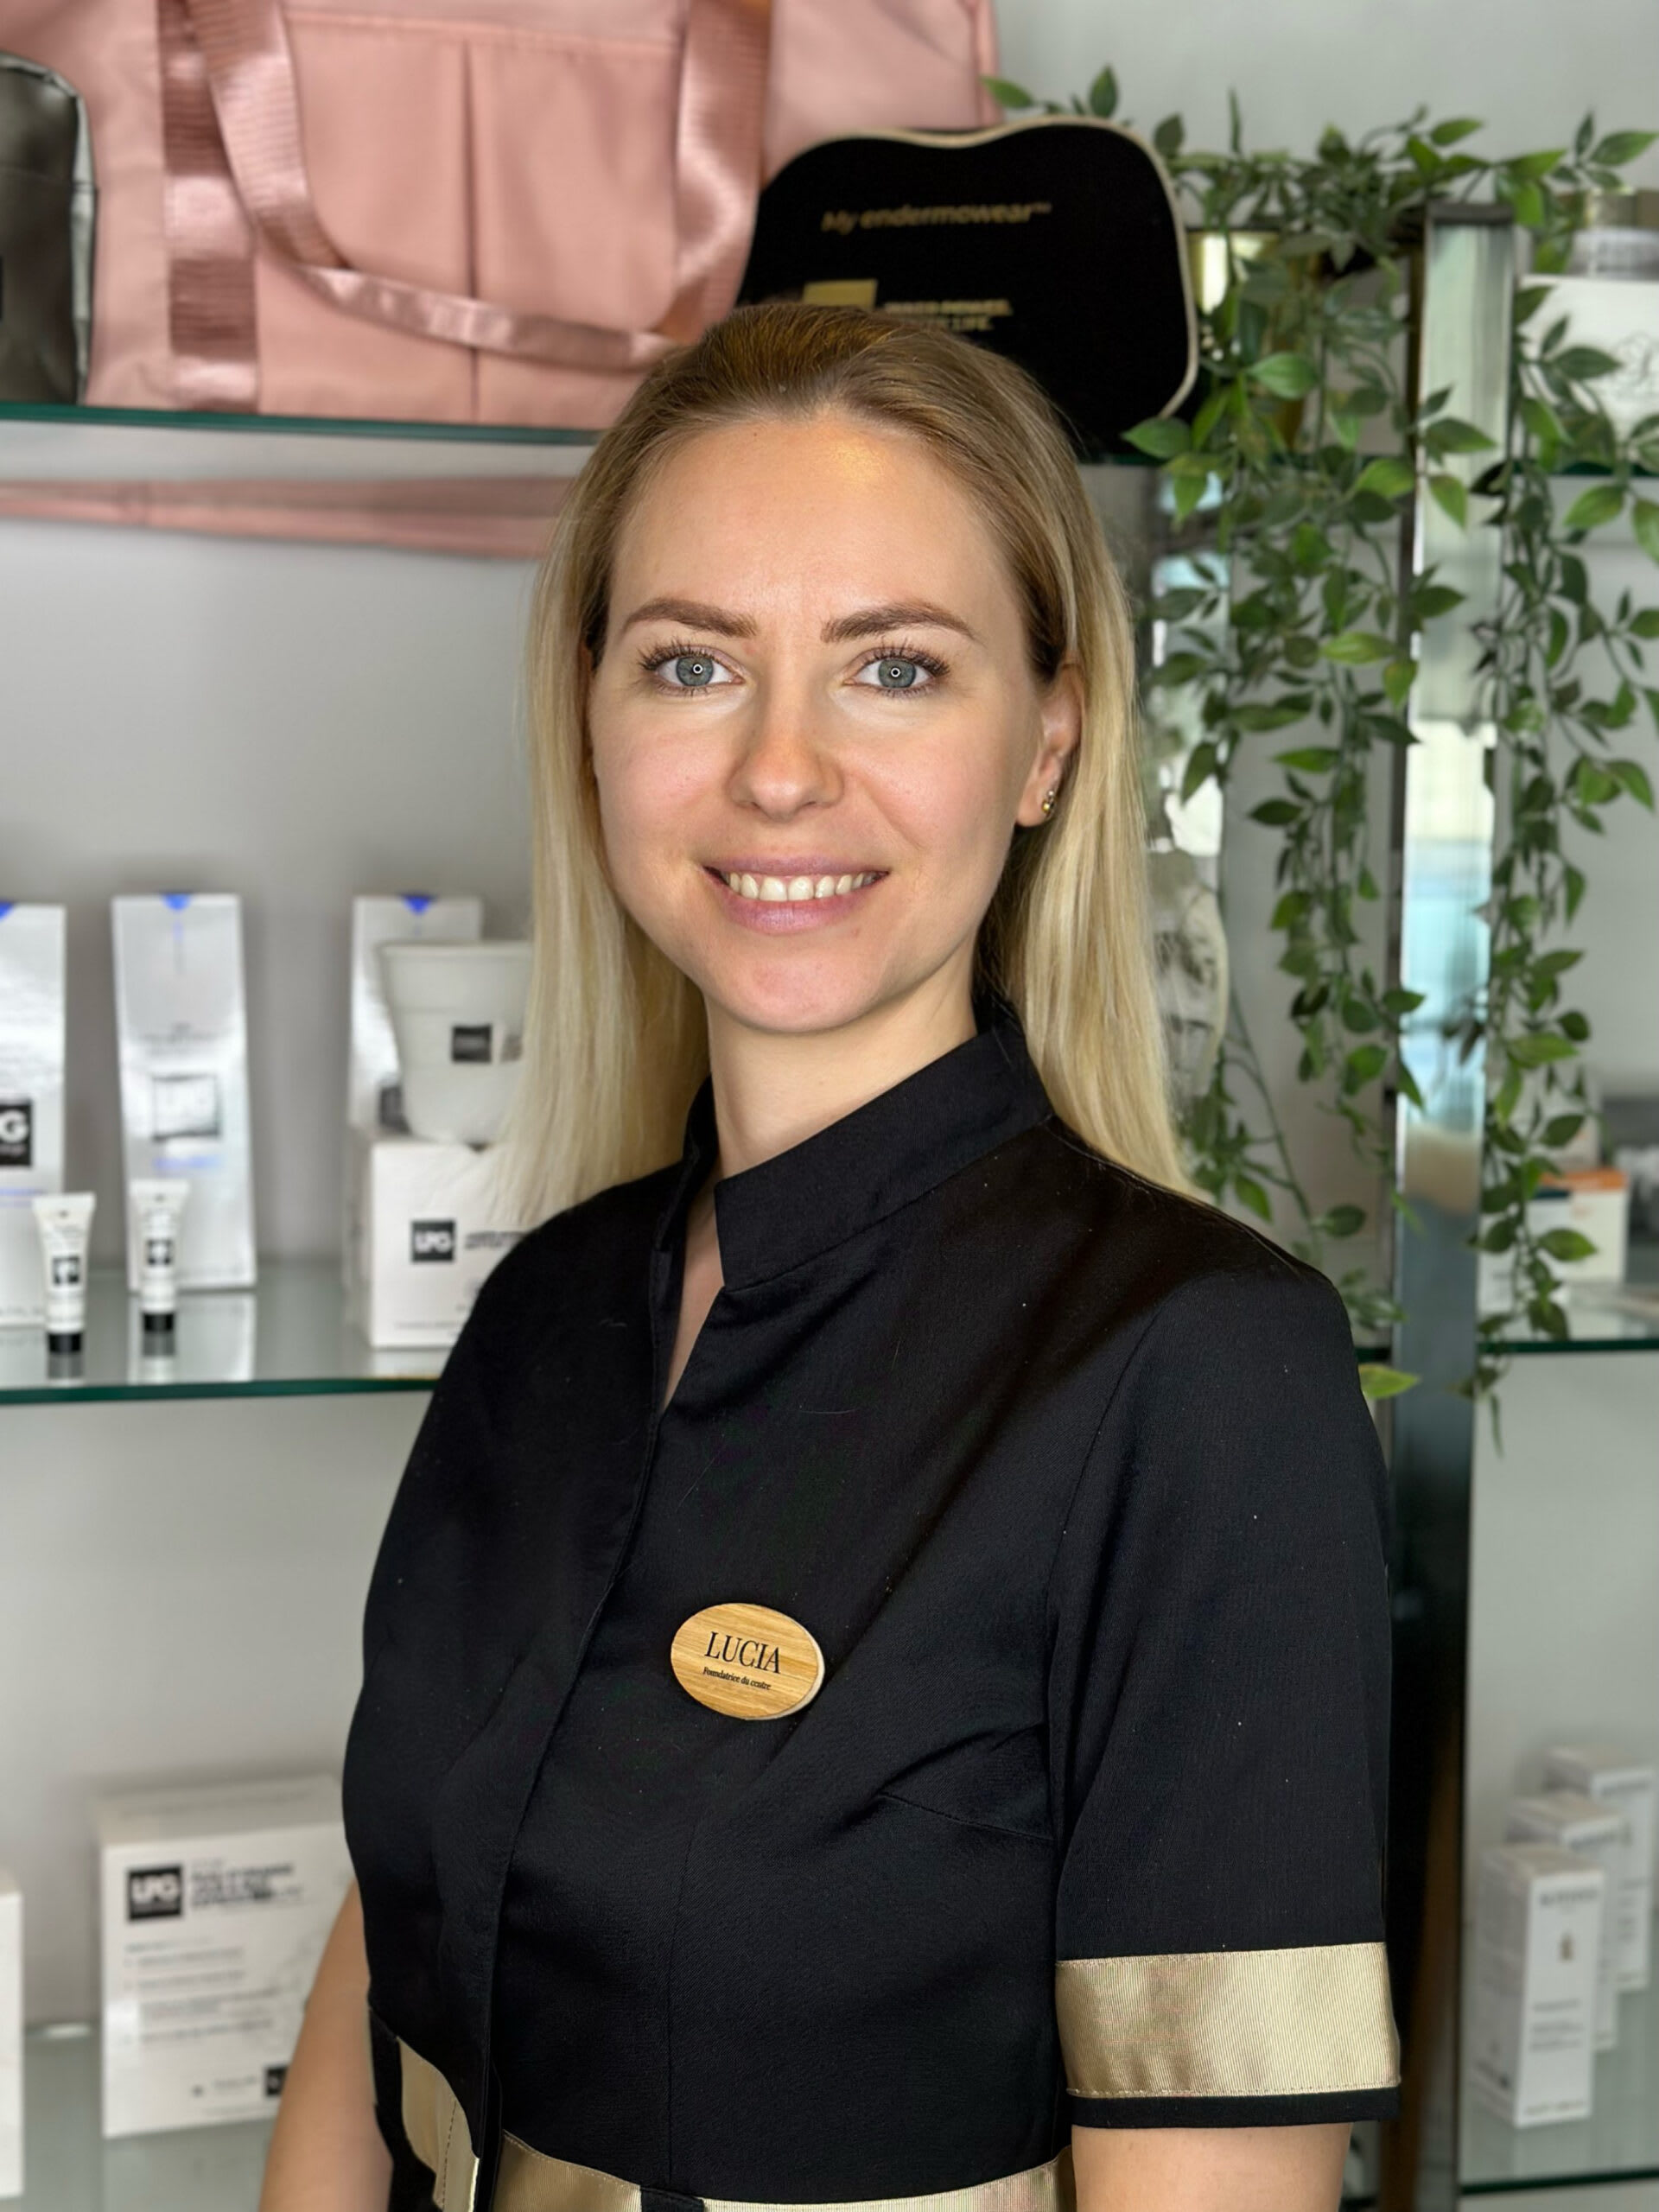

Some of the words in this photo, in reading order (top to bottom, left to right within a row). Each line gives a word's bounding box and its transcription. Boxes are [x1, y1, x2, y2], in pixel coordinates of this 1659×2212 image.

[703, 1630, 781, 1675] LUCIA
[741, 1675, 750, 1686] du
[750, 1679, 772, 1690] centre
